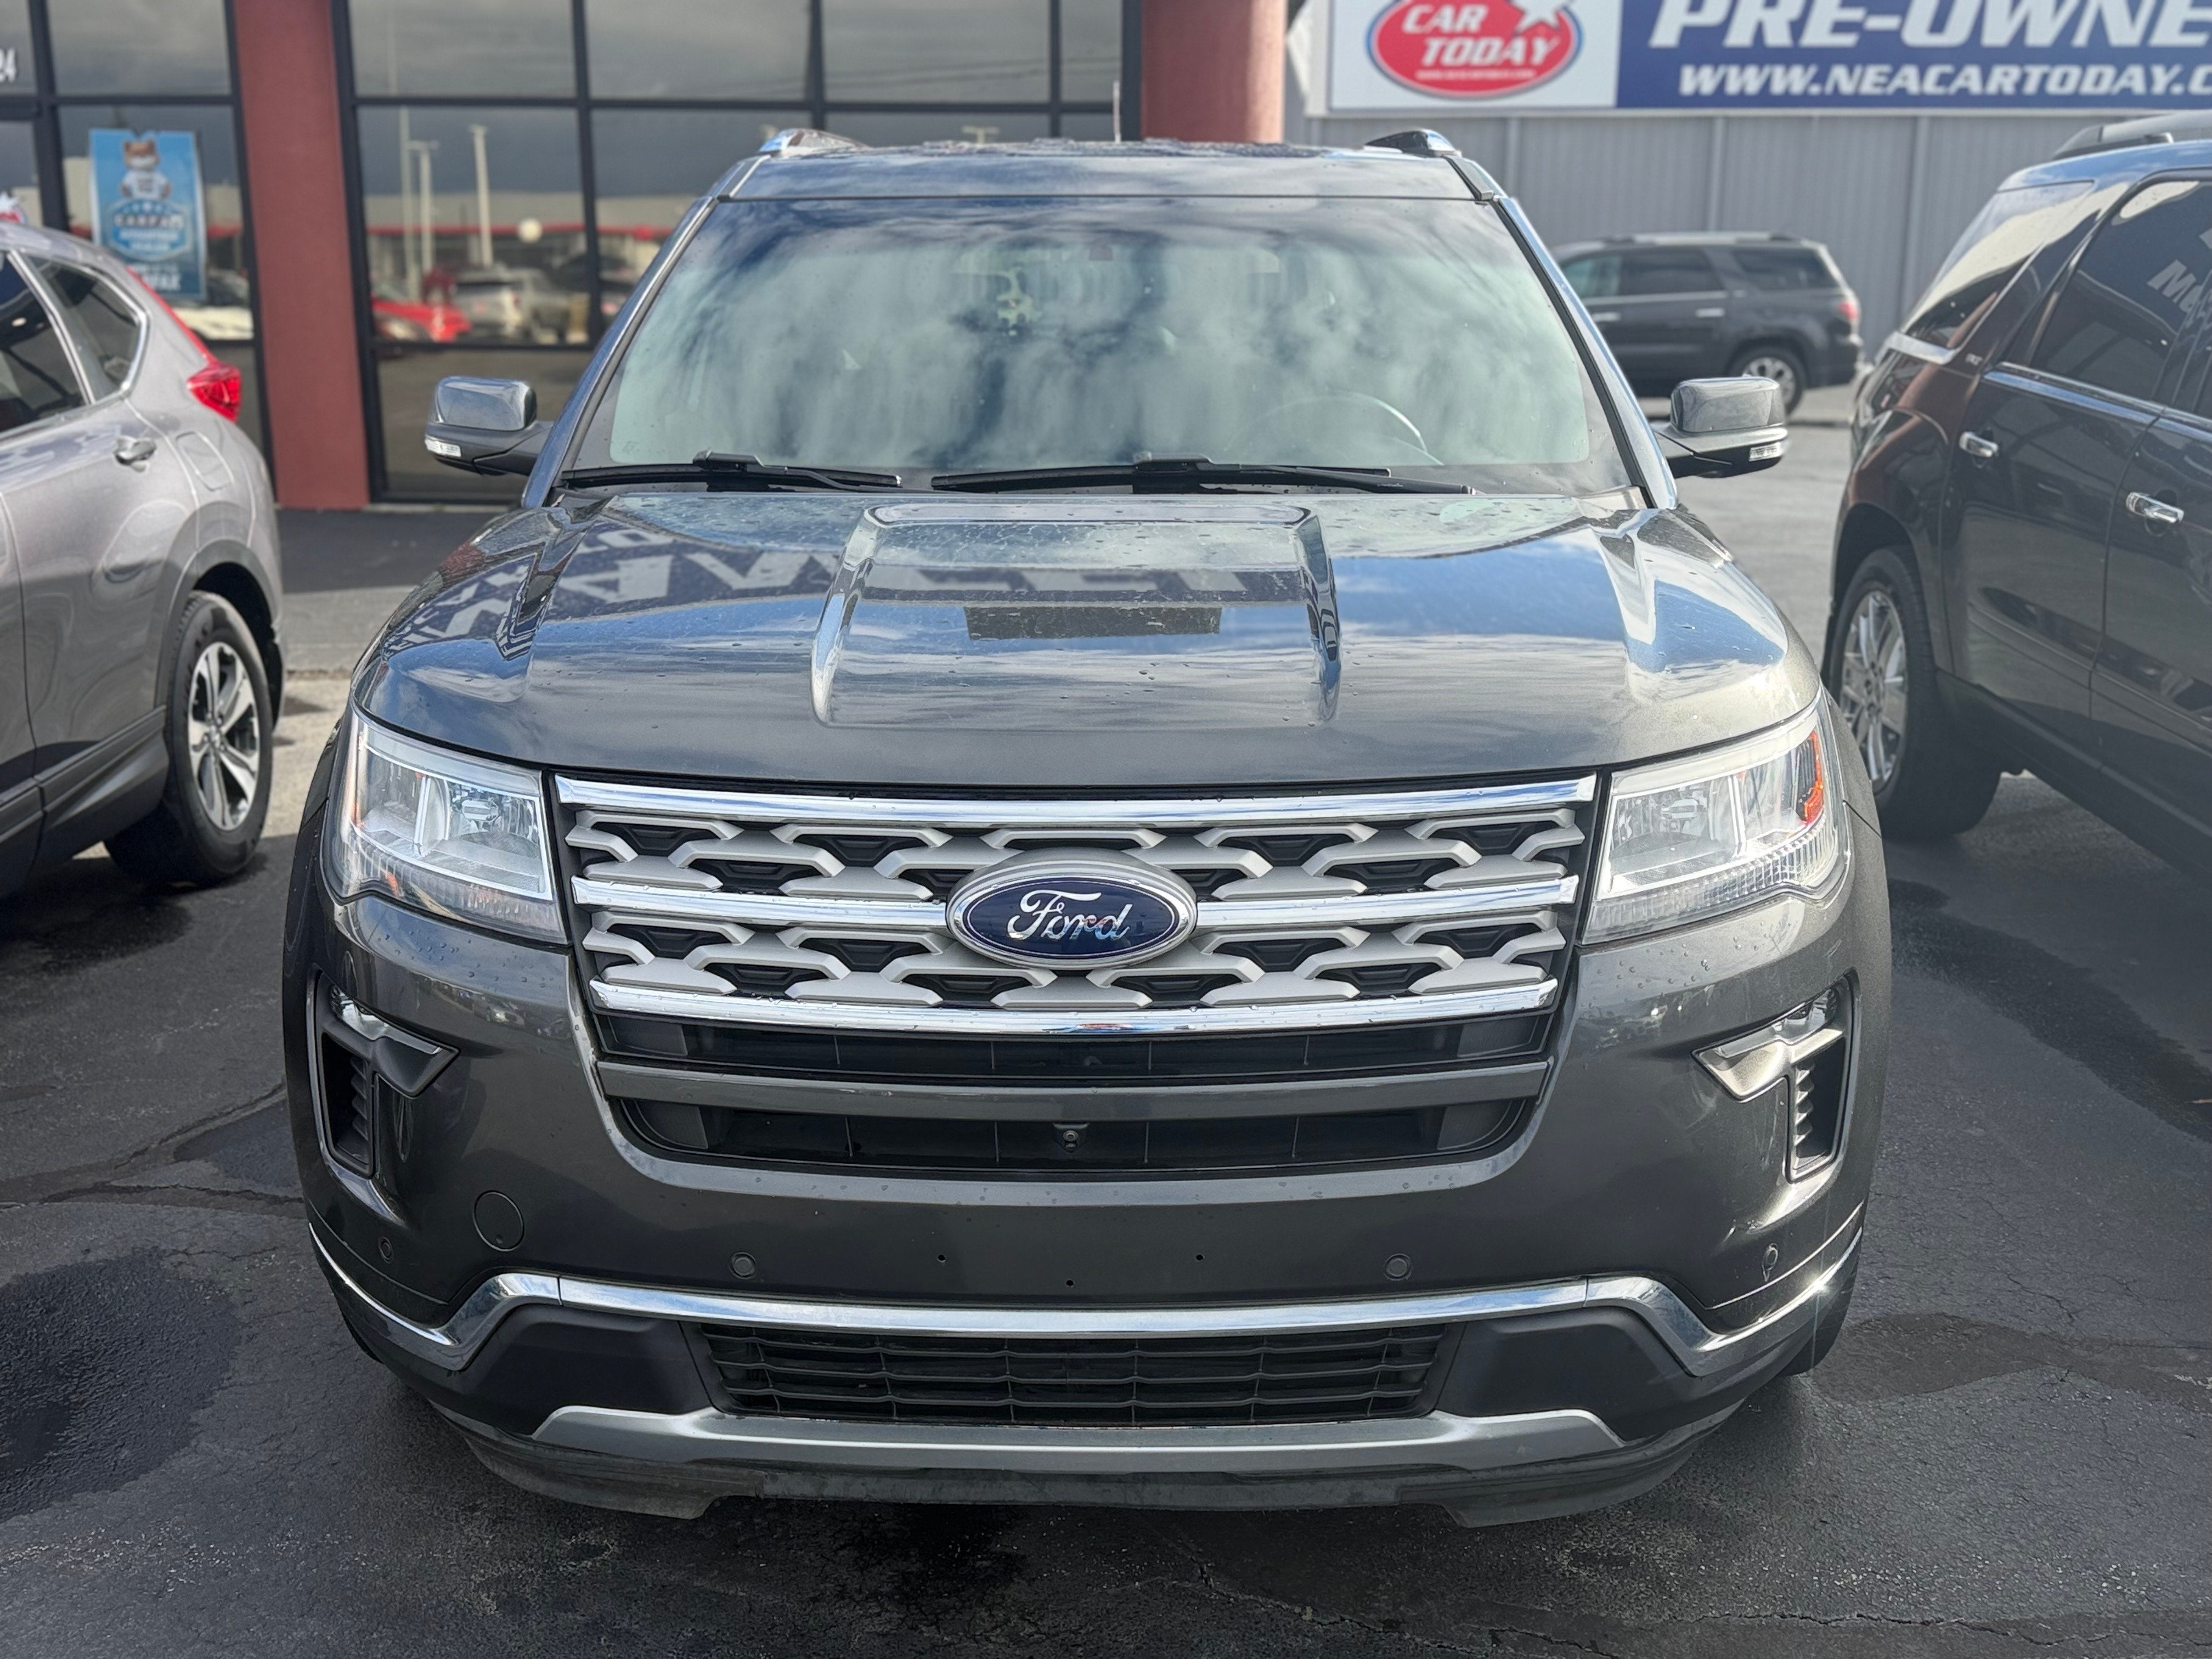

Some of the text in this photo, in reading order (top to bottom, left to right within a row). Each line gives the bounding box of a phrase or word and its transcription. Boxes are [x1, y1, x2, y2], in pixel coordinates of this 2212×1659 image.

[1402, 4, 1488, 34] CAR
[1647, 0, 2212, 48] PRE-OWNE
[1421, 36, 1561, 66] TODAY
[1006, 889, 1133, 940] Ford
